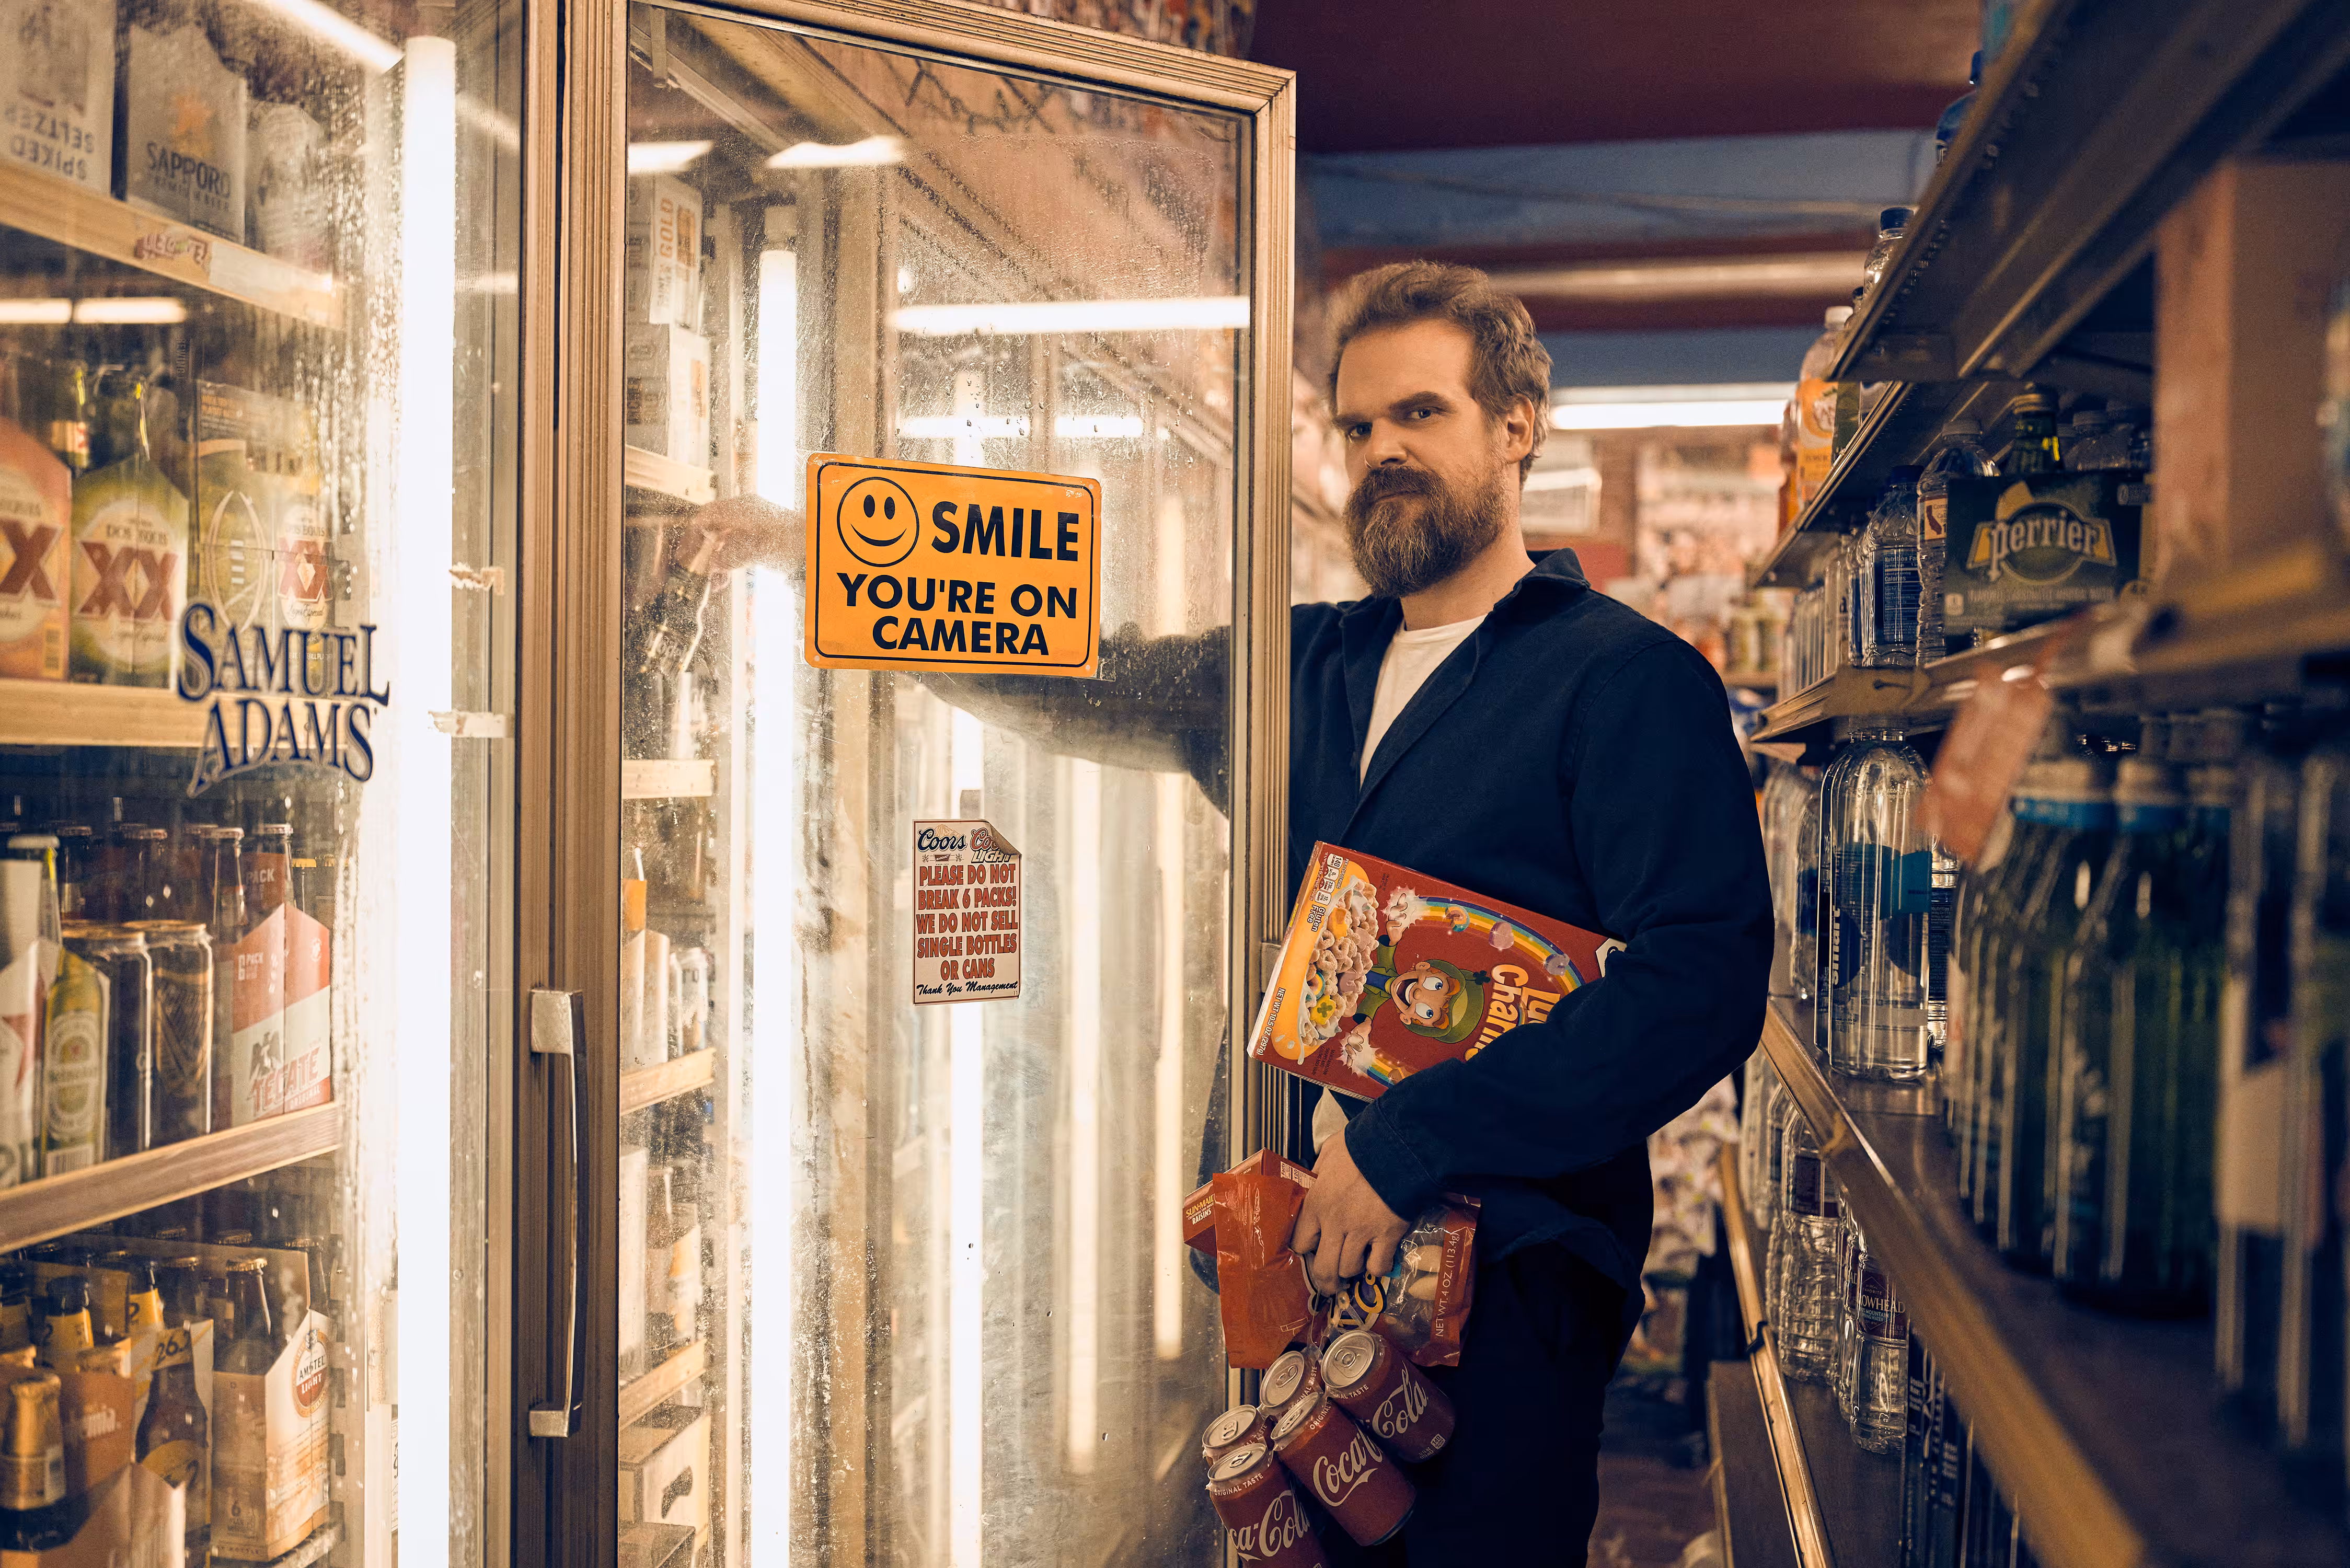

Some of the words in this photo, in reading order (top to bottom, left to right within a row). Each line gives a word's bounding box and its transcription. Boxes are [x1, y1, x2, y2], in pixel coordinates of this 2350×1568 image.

[147, 142, 231, 199] SAPPORO
[659, 197, 674, 259] GOLD
[931, 500, 1080, 562] SMILE
[836, 572, 996, 615] YOU'RE
[1010, 583, 1078, 619] ON
[872, 615, 1050, 656] CAMERA
[176, 602, 390, 707] SAMUEL
[187, 696, 374, 799] ADAMS
[917, 827, 967, 852] Coors
[919, 865, 964, 887] PLEASE
[967, 863, 986, 885] DO
[990, 863, 1016, 884] NOT
[1333, 857, 1342, 869] 140
[918, 889, 960, 910] BREAK
[962, 887, 971, 909] 6
[974, 886, 1017, 908] PACKS!
[916, 913, 935, 935] WE
[939, 912, 958, 933] DO
[961, 910, 988, 932] NOT
[990, 910, 1018, 931] SELL
[1307, 904, 1319, 924] Free
[1311, 906, 1326, 932] Gluten
[917, 936, 963, 959] SINGLE
[966, 932, 1017, 956] BOTTLES
[246, 952, 264, 964] PACK
[940, 960, 960, 982] OR
[962, 957, 995, 980] CANS
[916, 982, 943, 996] Thank
[946, 981, 963, 997] You
[965, 979, 1018, 994] Management
[1275, 987, 1286, 1001] NET
[1272, 1000, 1282, 1013] WT
[1264, 1026, 1273, 1036] OZ
[1267, 1012, 1277, 1027] 10.5
[1256, 1035, 1269, 1056] (297g)
[247, 1045, 322, 1117] TECATE
[1192, 1208, 1212, 1225] RAISINS
[1445, 1232, 1460, 1269] (113.4g)
[1442, 1270, 1453, 1288] OZ.
[1437, 1297, 1448, 1316] WT.
[1860, 1294, 1906, 1313] OWHEAD
[1865, 1309, 1890, 1318] MOUNTAIN
[1435, 1317, 1444, 1337] NET
[299, 1355, 326, 1380] AMSTEL
[301, 1373, 322, 1394] LIGHT
[1349, 1383, 1369, 1399] TASTE
[1309, 1404, 1331, 1431] ORIGINAL
[1432, 1435, 1441, 1445] 140
[1214, 1484, 1242, 1497] ORIGINAL
[1242, 1472, 1264, 1490] TASTE
[1229, 1480, 1310, 1557] ca-Cola
